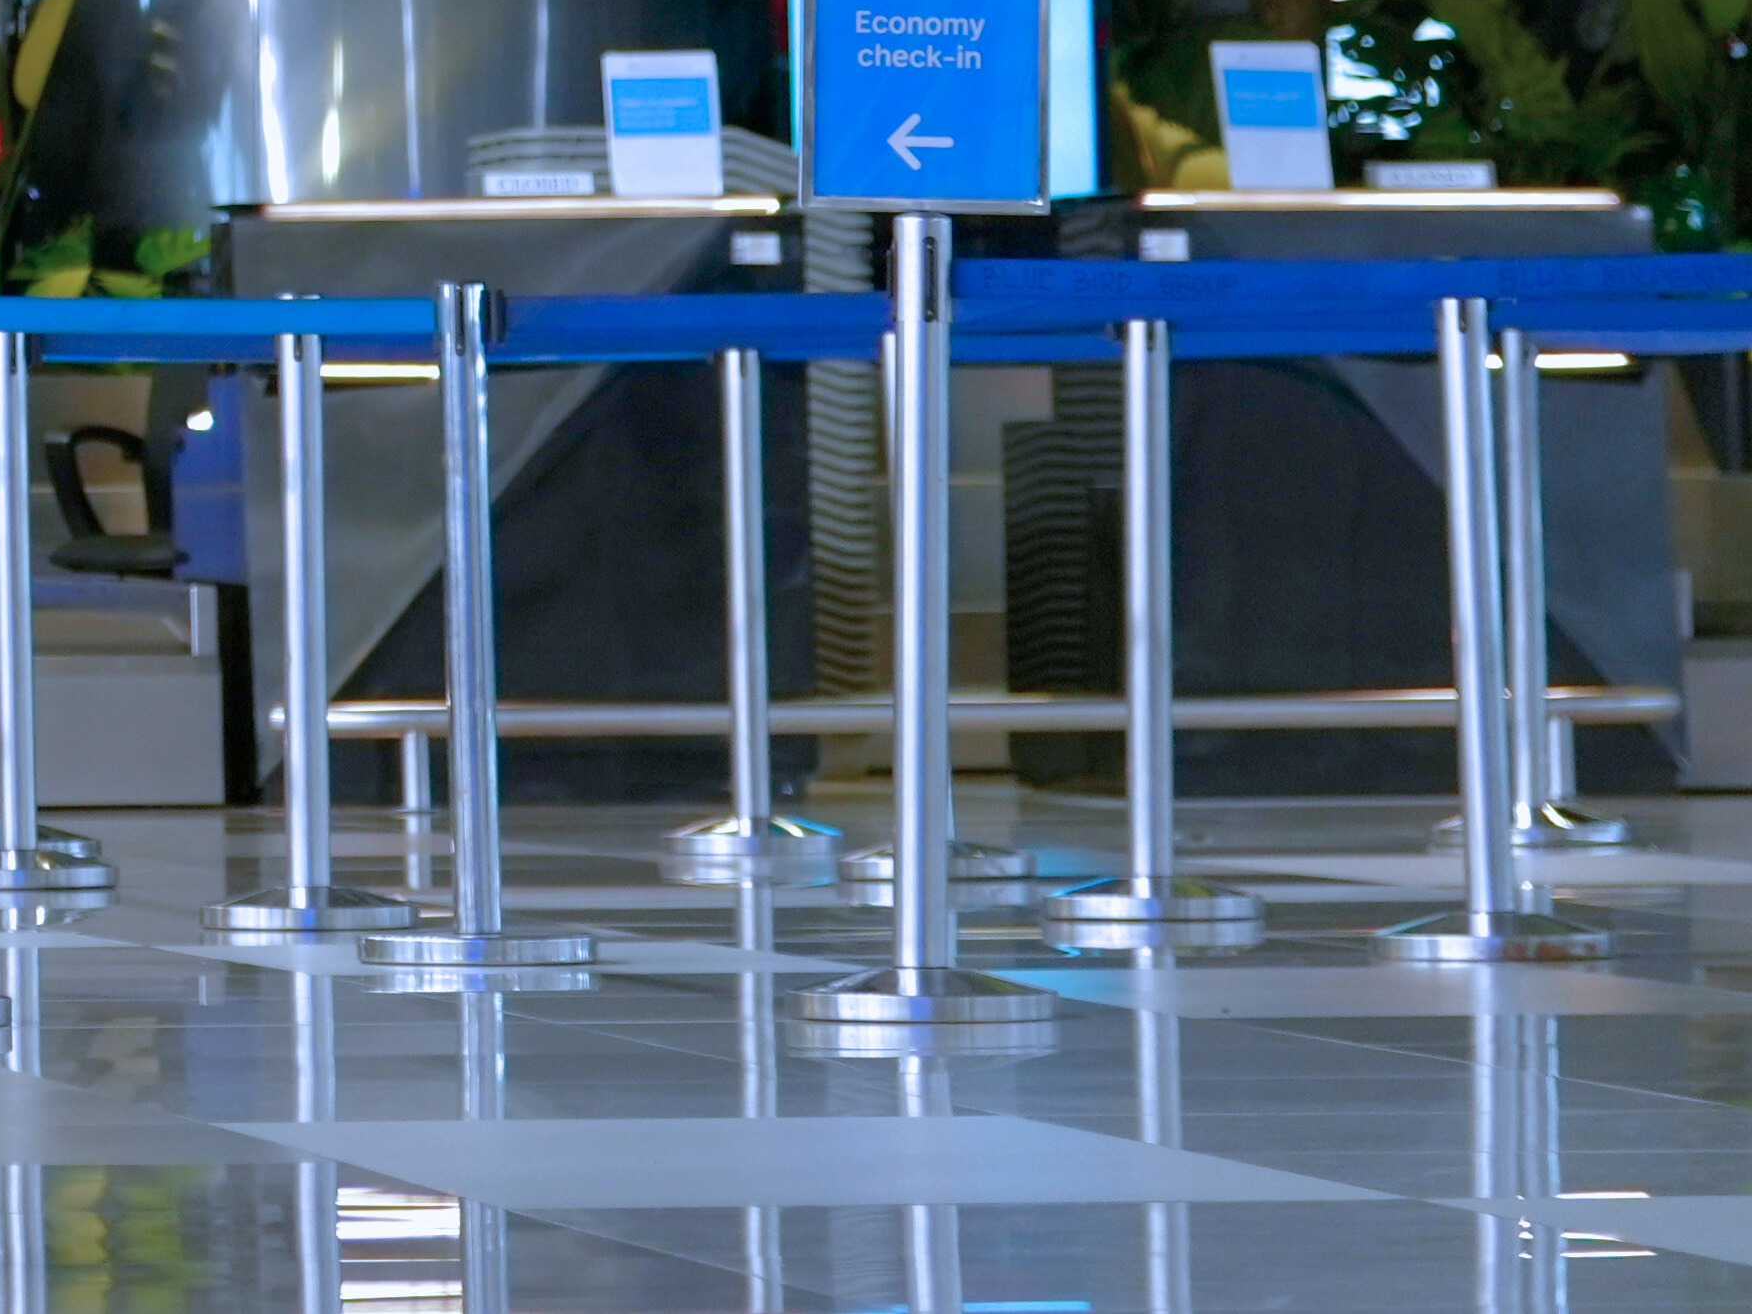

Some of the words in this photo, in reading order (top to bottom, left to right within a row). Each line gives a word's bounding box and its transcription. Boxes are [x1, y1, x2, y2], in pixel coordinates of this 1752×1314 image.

[855, 10, 985, 41] Economy
[857, 43, 982, 69] check-in
[1073, 269, 1132, 292] BIRD
